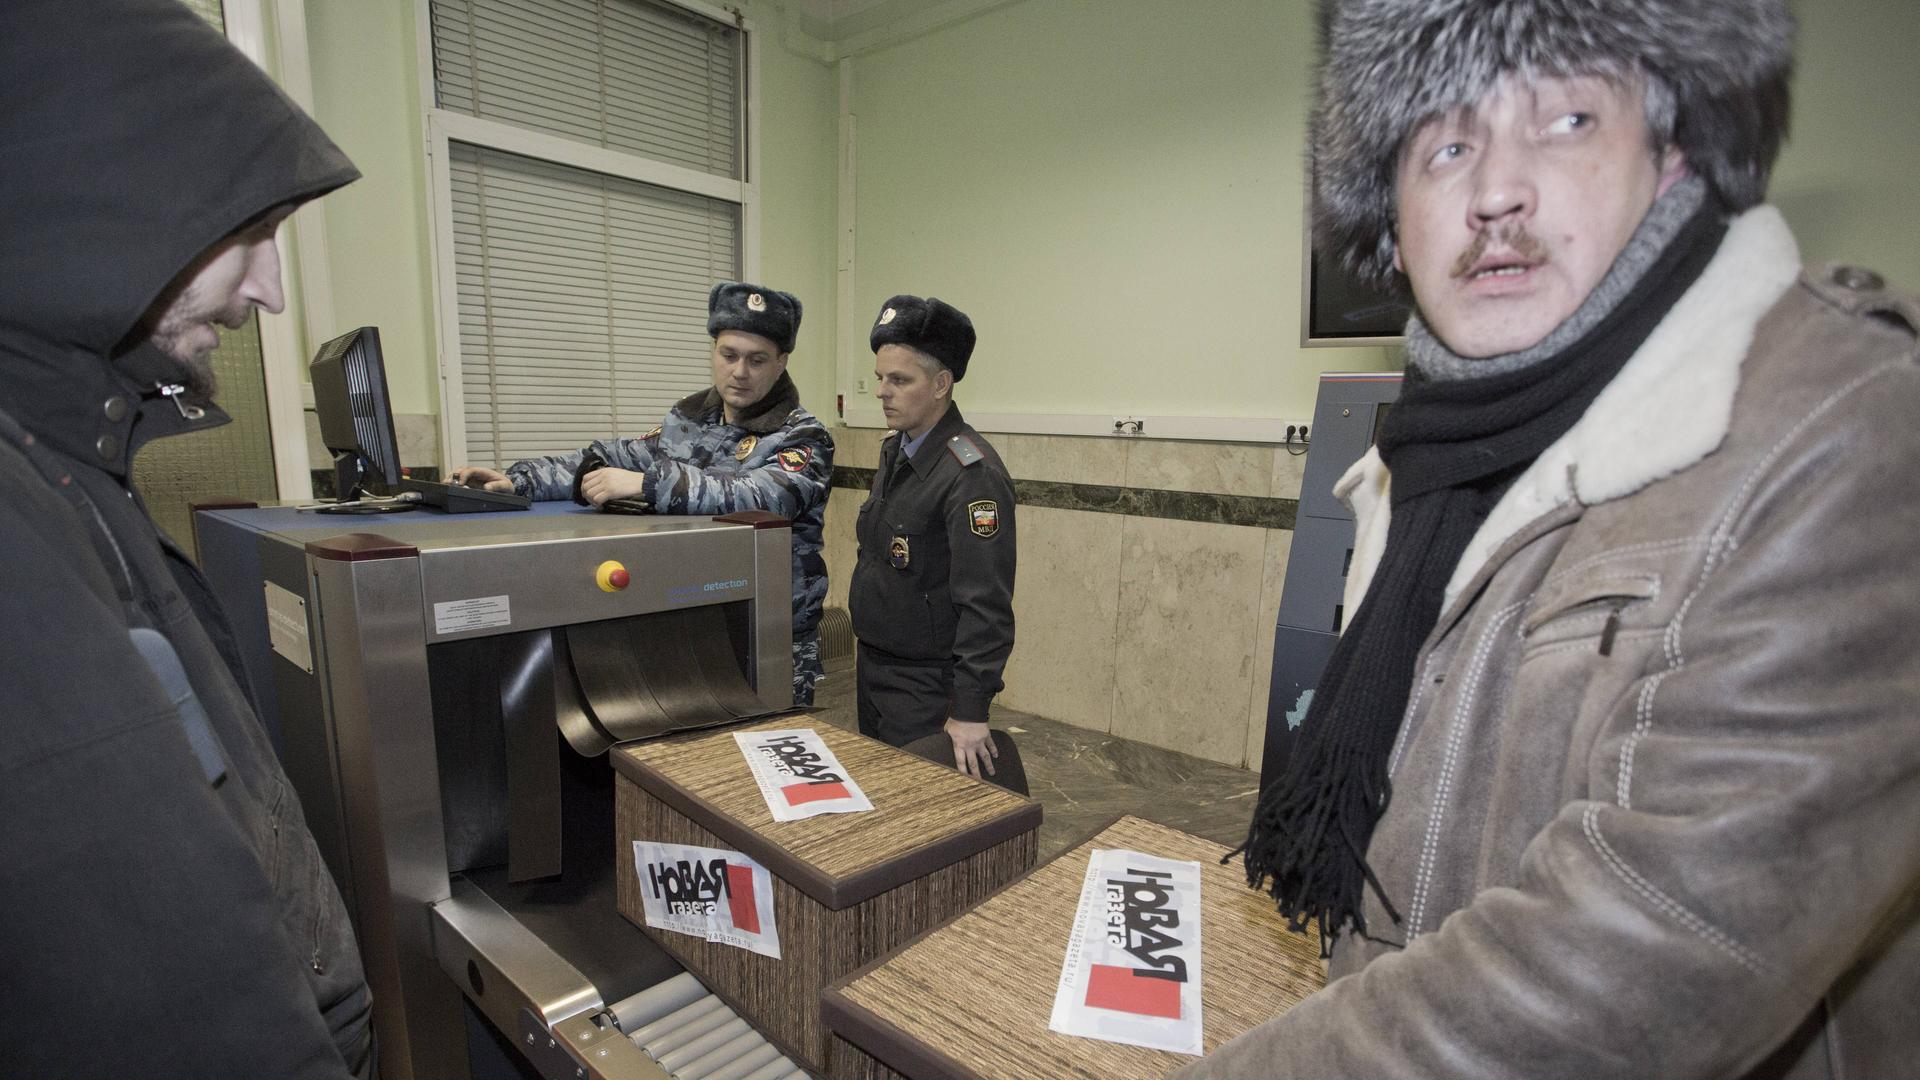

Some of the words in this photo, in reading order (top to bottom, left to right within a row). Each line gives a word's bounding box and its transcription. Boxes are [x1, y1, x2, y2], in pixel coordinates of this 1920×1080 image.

[972, 503, 995, 512] РОССИЯ
[978, 525, 994, 533] МВД
[703, 578, 748, 591] detection
